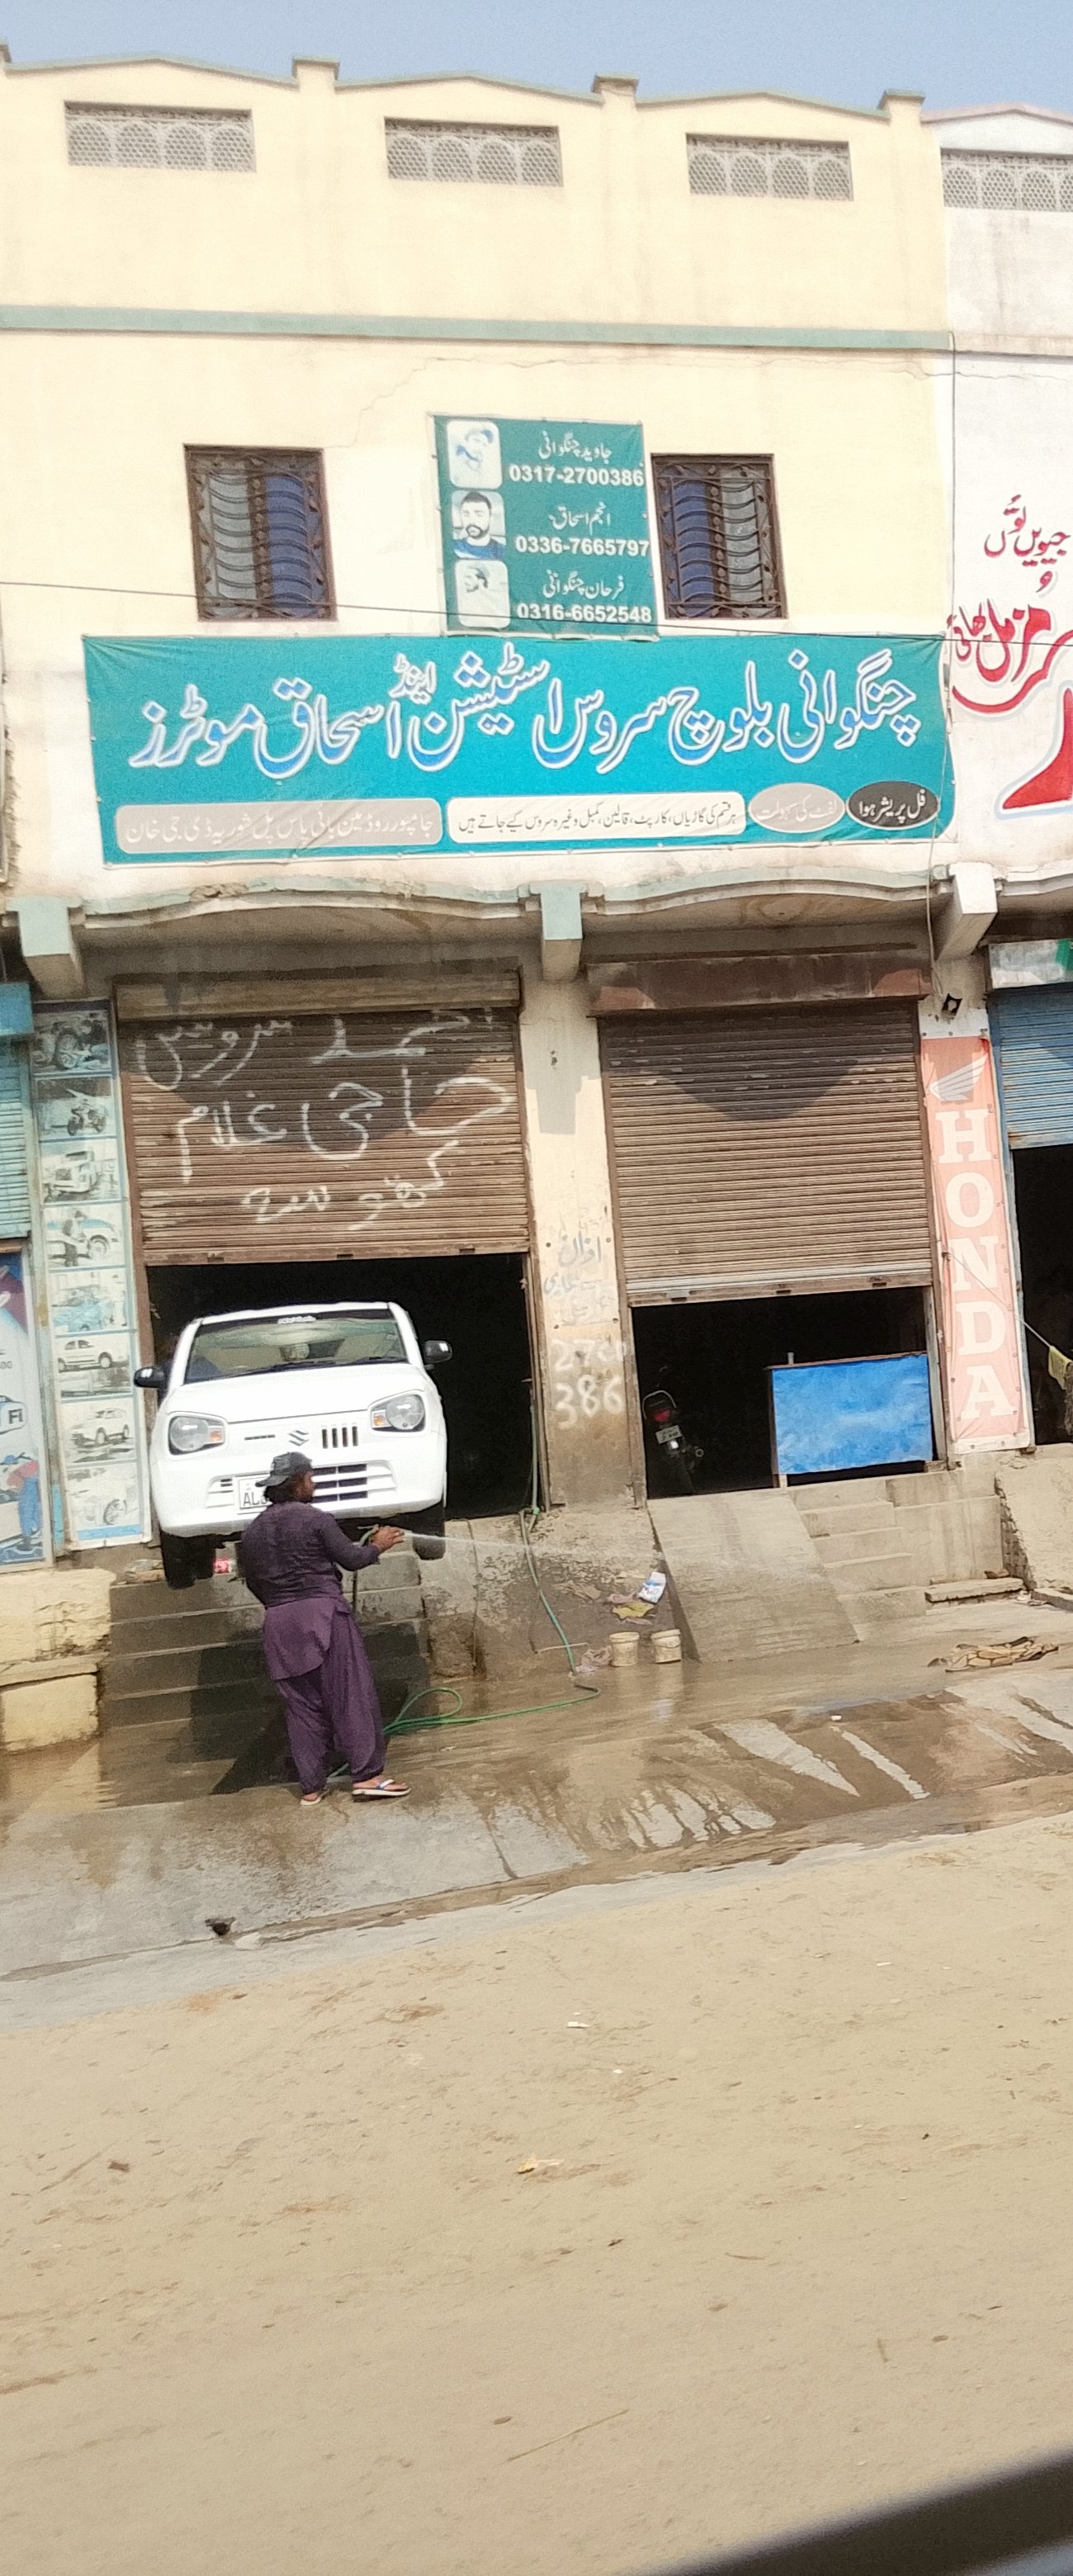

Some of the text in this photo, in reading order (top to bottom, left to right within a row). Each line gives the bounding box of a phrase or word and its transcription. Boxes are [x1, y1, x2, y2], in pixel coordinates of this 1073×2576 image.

[508, 463, 645, 486] 0317-2700386
[548, 504, 590, 530] اسحاق
[515, 535, 650, 556] 0336-7665797
[584, 575, 625, 600] فرحان
[517, 603, 653, 623] 0316-6652548
[387, 652, 437, 704] اینڈ
[408, 641, 563, 772] اسٹیشن
[668, 661, 775, 766] بلوچ
[778, 648, 922, 765] چنگوانی
[128, 683, 262, 768] موٹرز
[254, 677, 401, 779] اسحاق
[532, 688, 668, 774] سروس
[706, 803, 719, 824] کی
[716, 801, 731, 828] قسم
[756, 794, 837, 822] لفٹ کی سہولت
[858, 800, 876, 817] ہوا
[907, 788, 927, 819] فل
[125, 820, 160, 844] خان
[277, 815, 310, 845] پاس
[459, 817, 475, 834] ہیں
[478, 814, 506, 833] جاتے
[525, 815, 554, 832] سروس
[726, 813, 737, 826] ہر
[176, 1065, 516, 1184] حاجی غلام
[934, 1108, 1016, 1420] HONDA
[554, 1374, 625, 1430] 386
